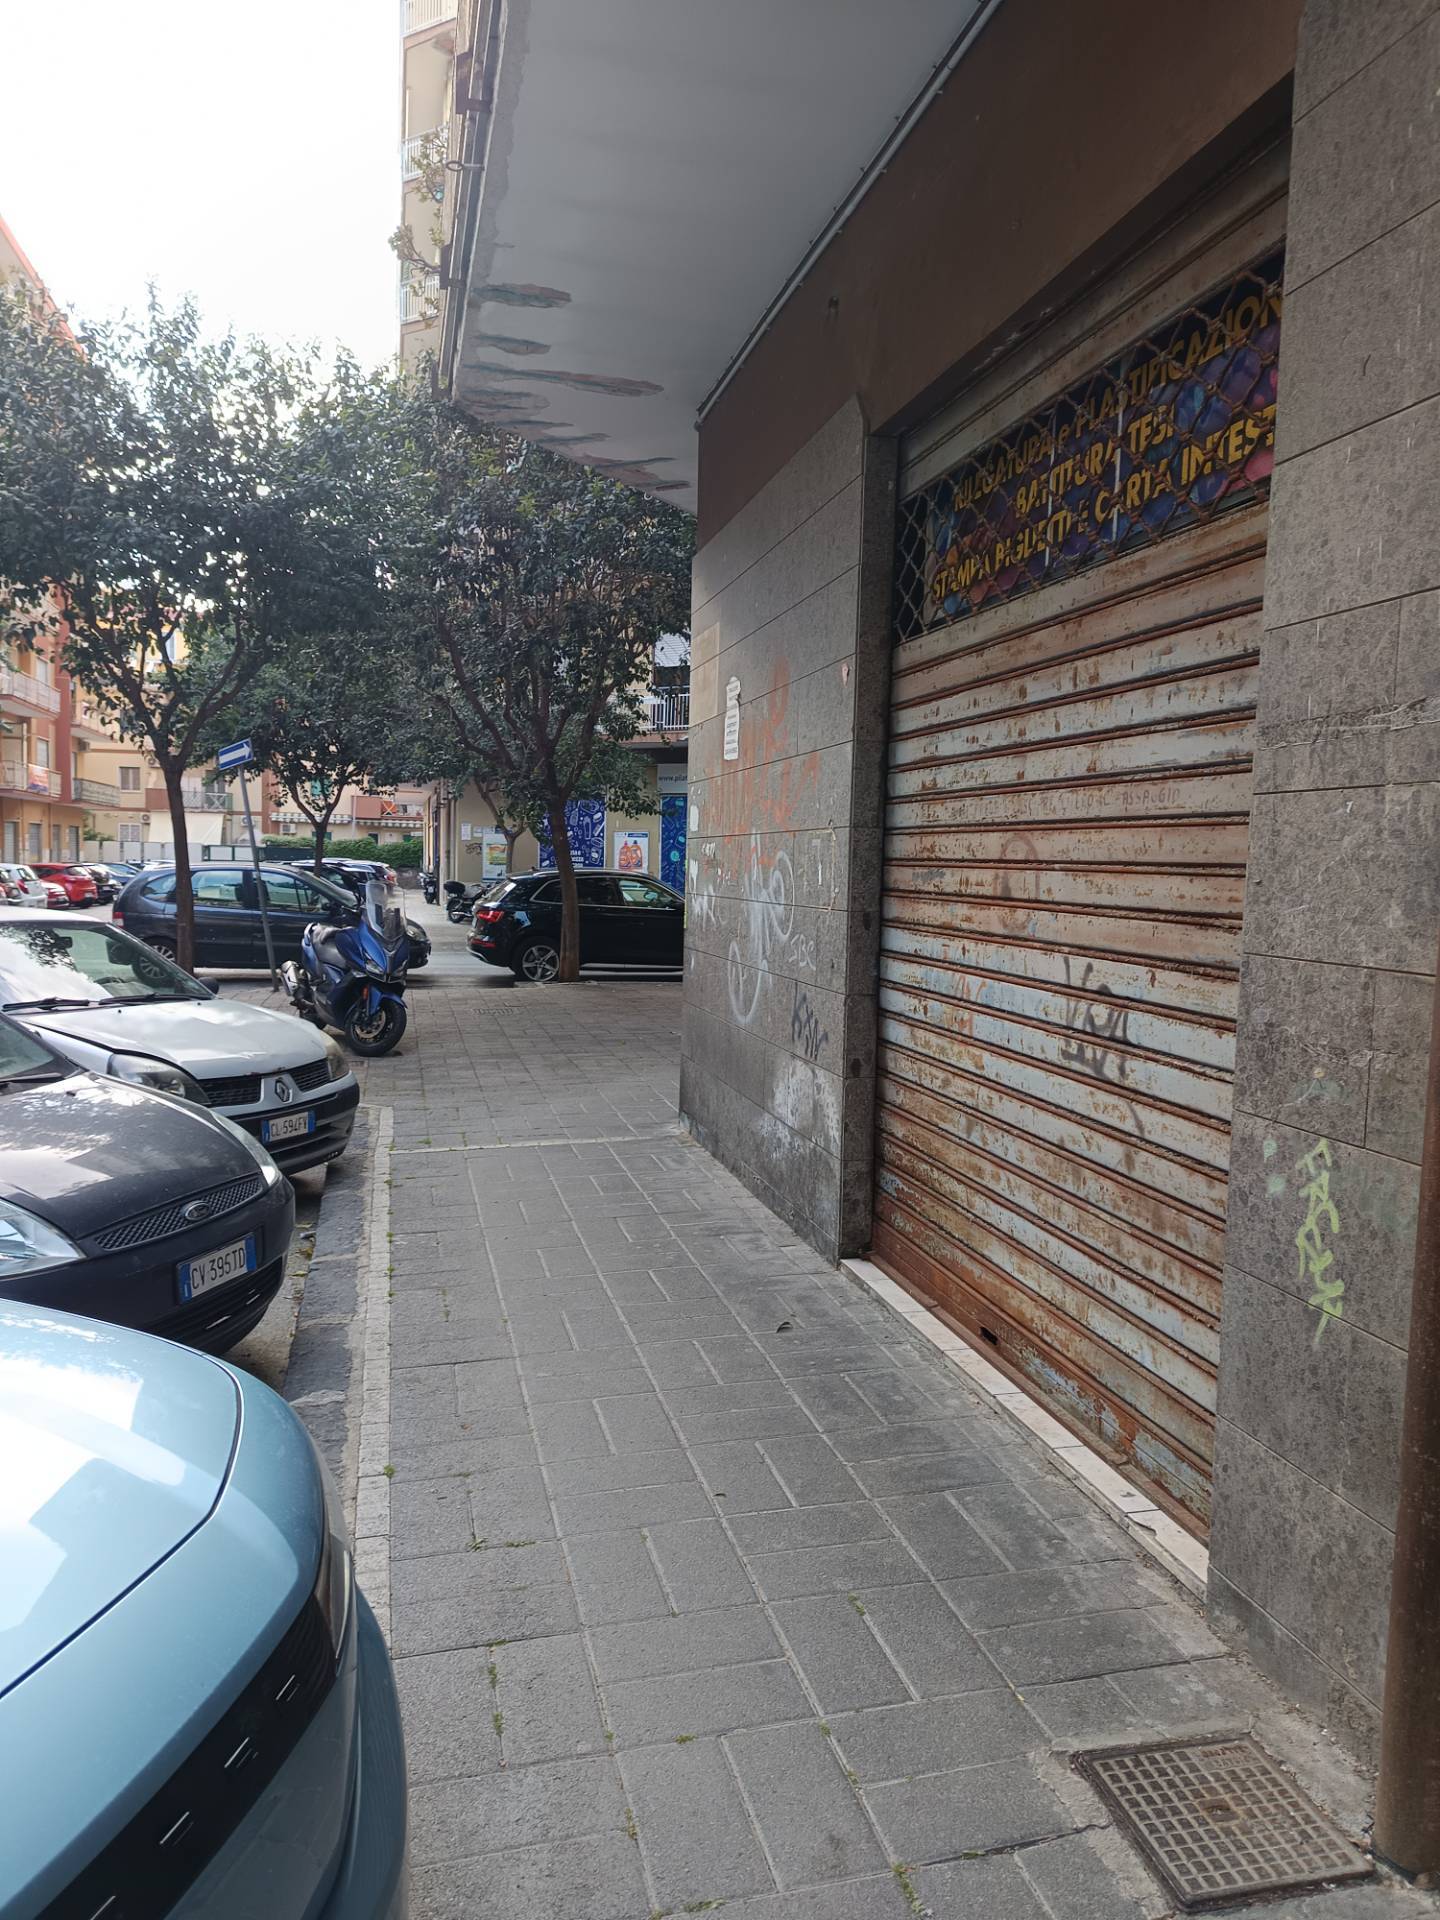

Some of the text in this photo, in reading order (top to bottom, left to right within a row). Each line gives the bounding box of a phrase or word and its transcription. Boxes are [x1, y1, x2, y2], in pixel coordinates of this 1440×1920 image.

[1015, 402, 1175, 513] BATTITURA TESI
[1094, 459, 1172, 523] CARTA
